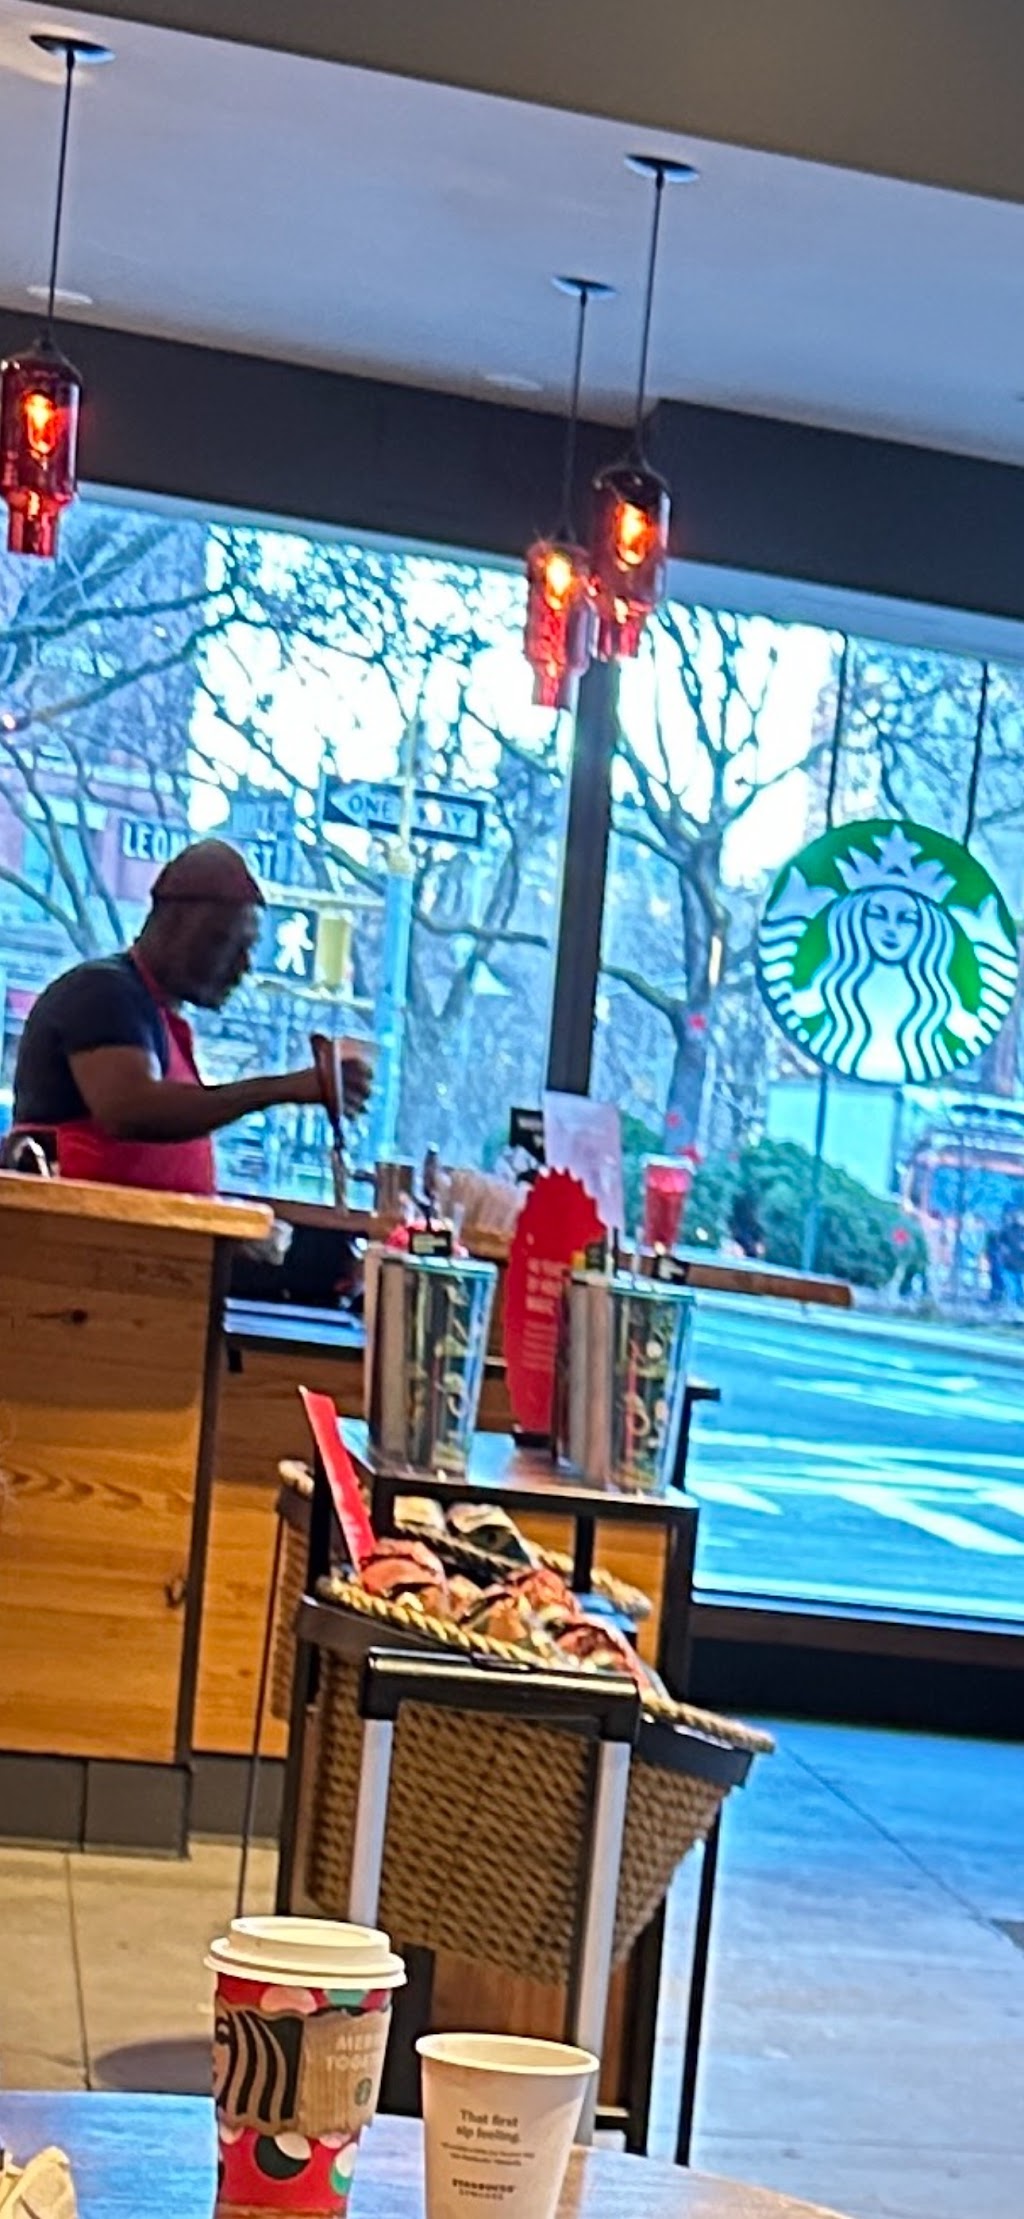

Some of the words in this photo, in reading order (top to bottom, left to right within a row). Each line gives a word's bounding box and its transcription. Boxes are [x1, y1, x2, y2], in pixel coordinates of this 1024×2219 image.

[348, 795, 391, 819] ONE
[246, 841, 274, 879] ST
[460, 2109, 487, 2125] That
[492, 2114, 518, 2127] first
[456, 2126, 474, 2139] sip
